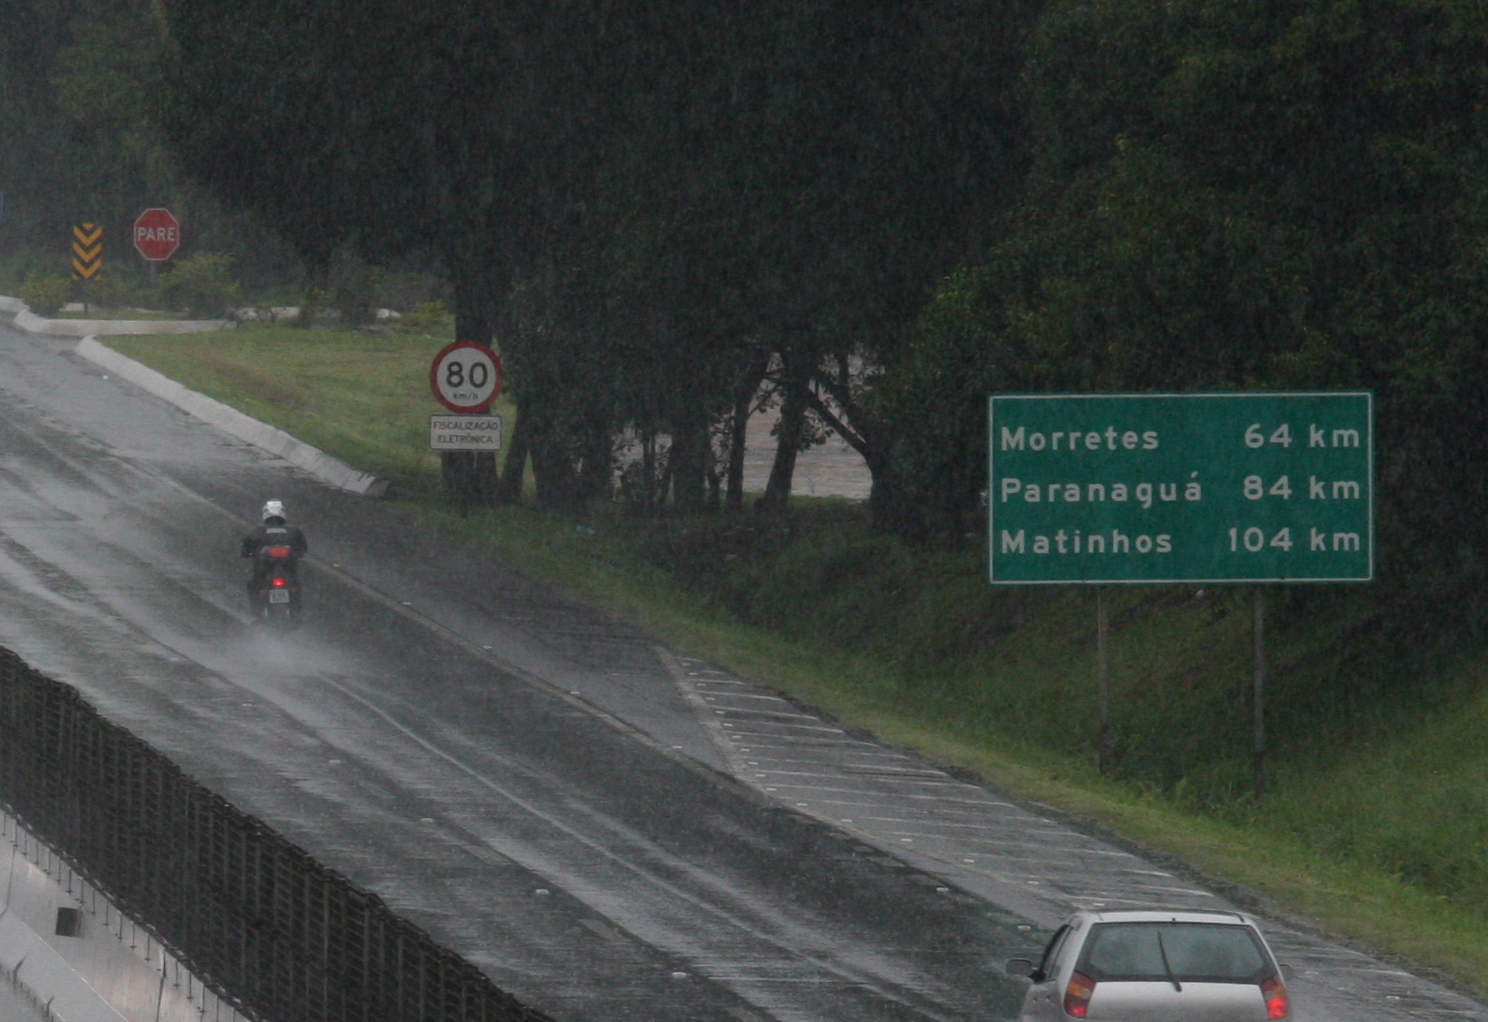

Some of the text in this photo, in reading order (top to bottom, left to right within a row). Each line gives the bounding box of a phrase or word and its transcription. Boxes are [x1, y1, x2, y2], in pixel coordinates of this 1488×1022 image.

[137, 226, 176, 242] PARE
[446, 361, 488, 388] 80
[453, 391, 479, 401] km/h
[433, 420, 498, 431] FISCALIZAÇÃO
[437, 432, 493, 444] ELETRÔNICA
[1001, 423, 1360, 451] Morretes 64 km
[1001, 471, 1360, 509] Paranaguá 84 km
[1001, 526, 1360, 554] Matinhos 104 km
